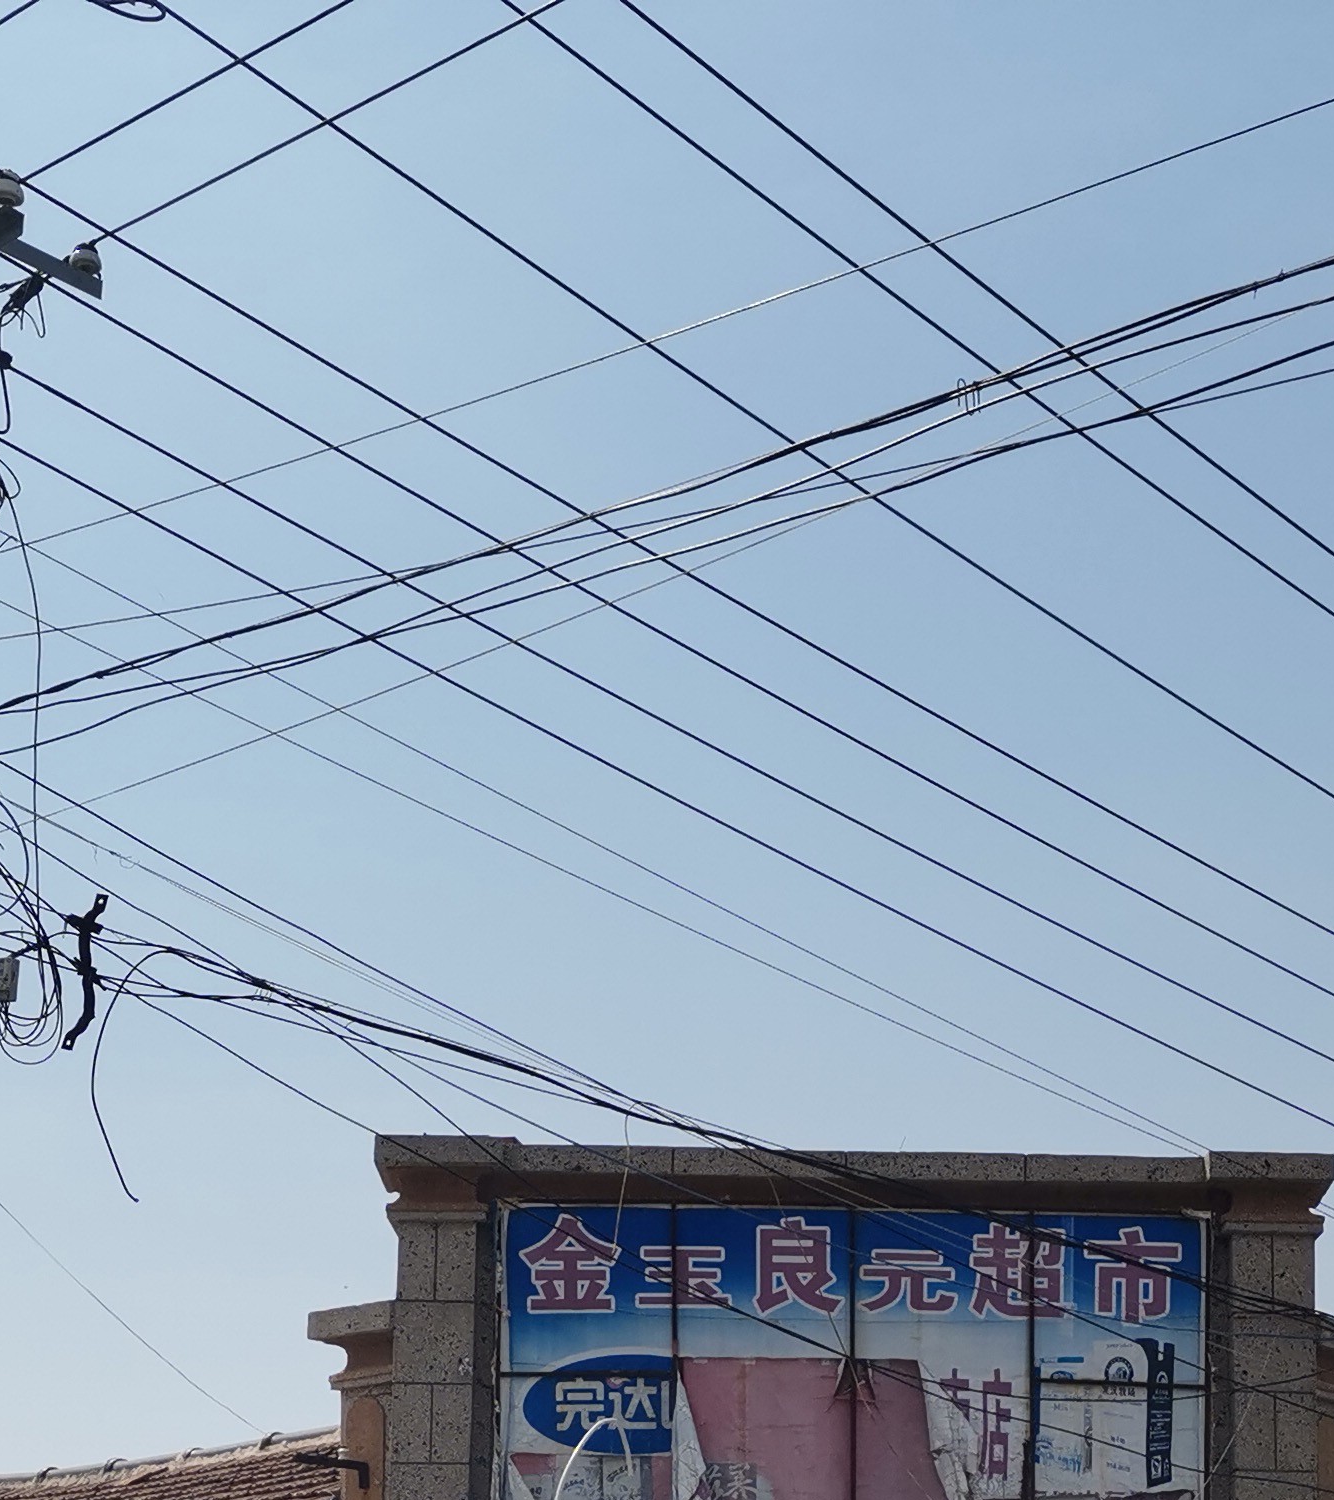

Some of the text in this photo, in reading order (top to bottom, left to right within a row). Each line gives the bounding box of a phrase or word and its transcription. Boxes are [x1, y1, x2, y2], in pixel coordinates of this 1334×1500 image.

[519, 1213, 1184, 1324] 金玉良元超市
[555, 1376, 673, 1432] 完达
